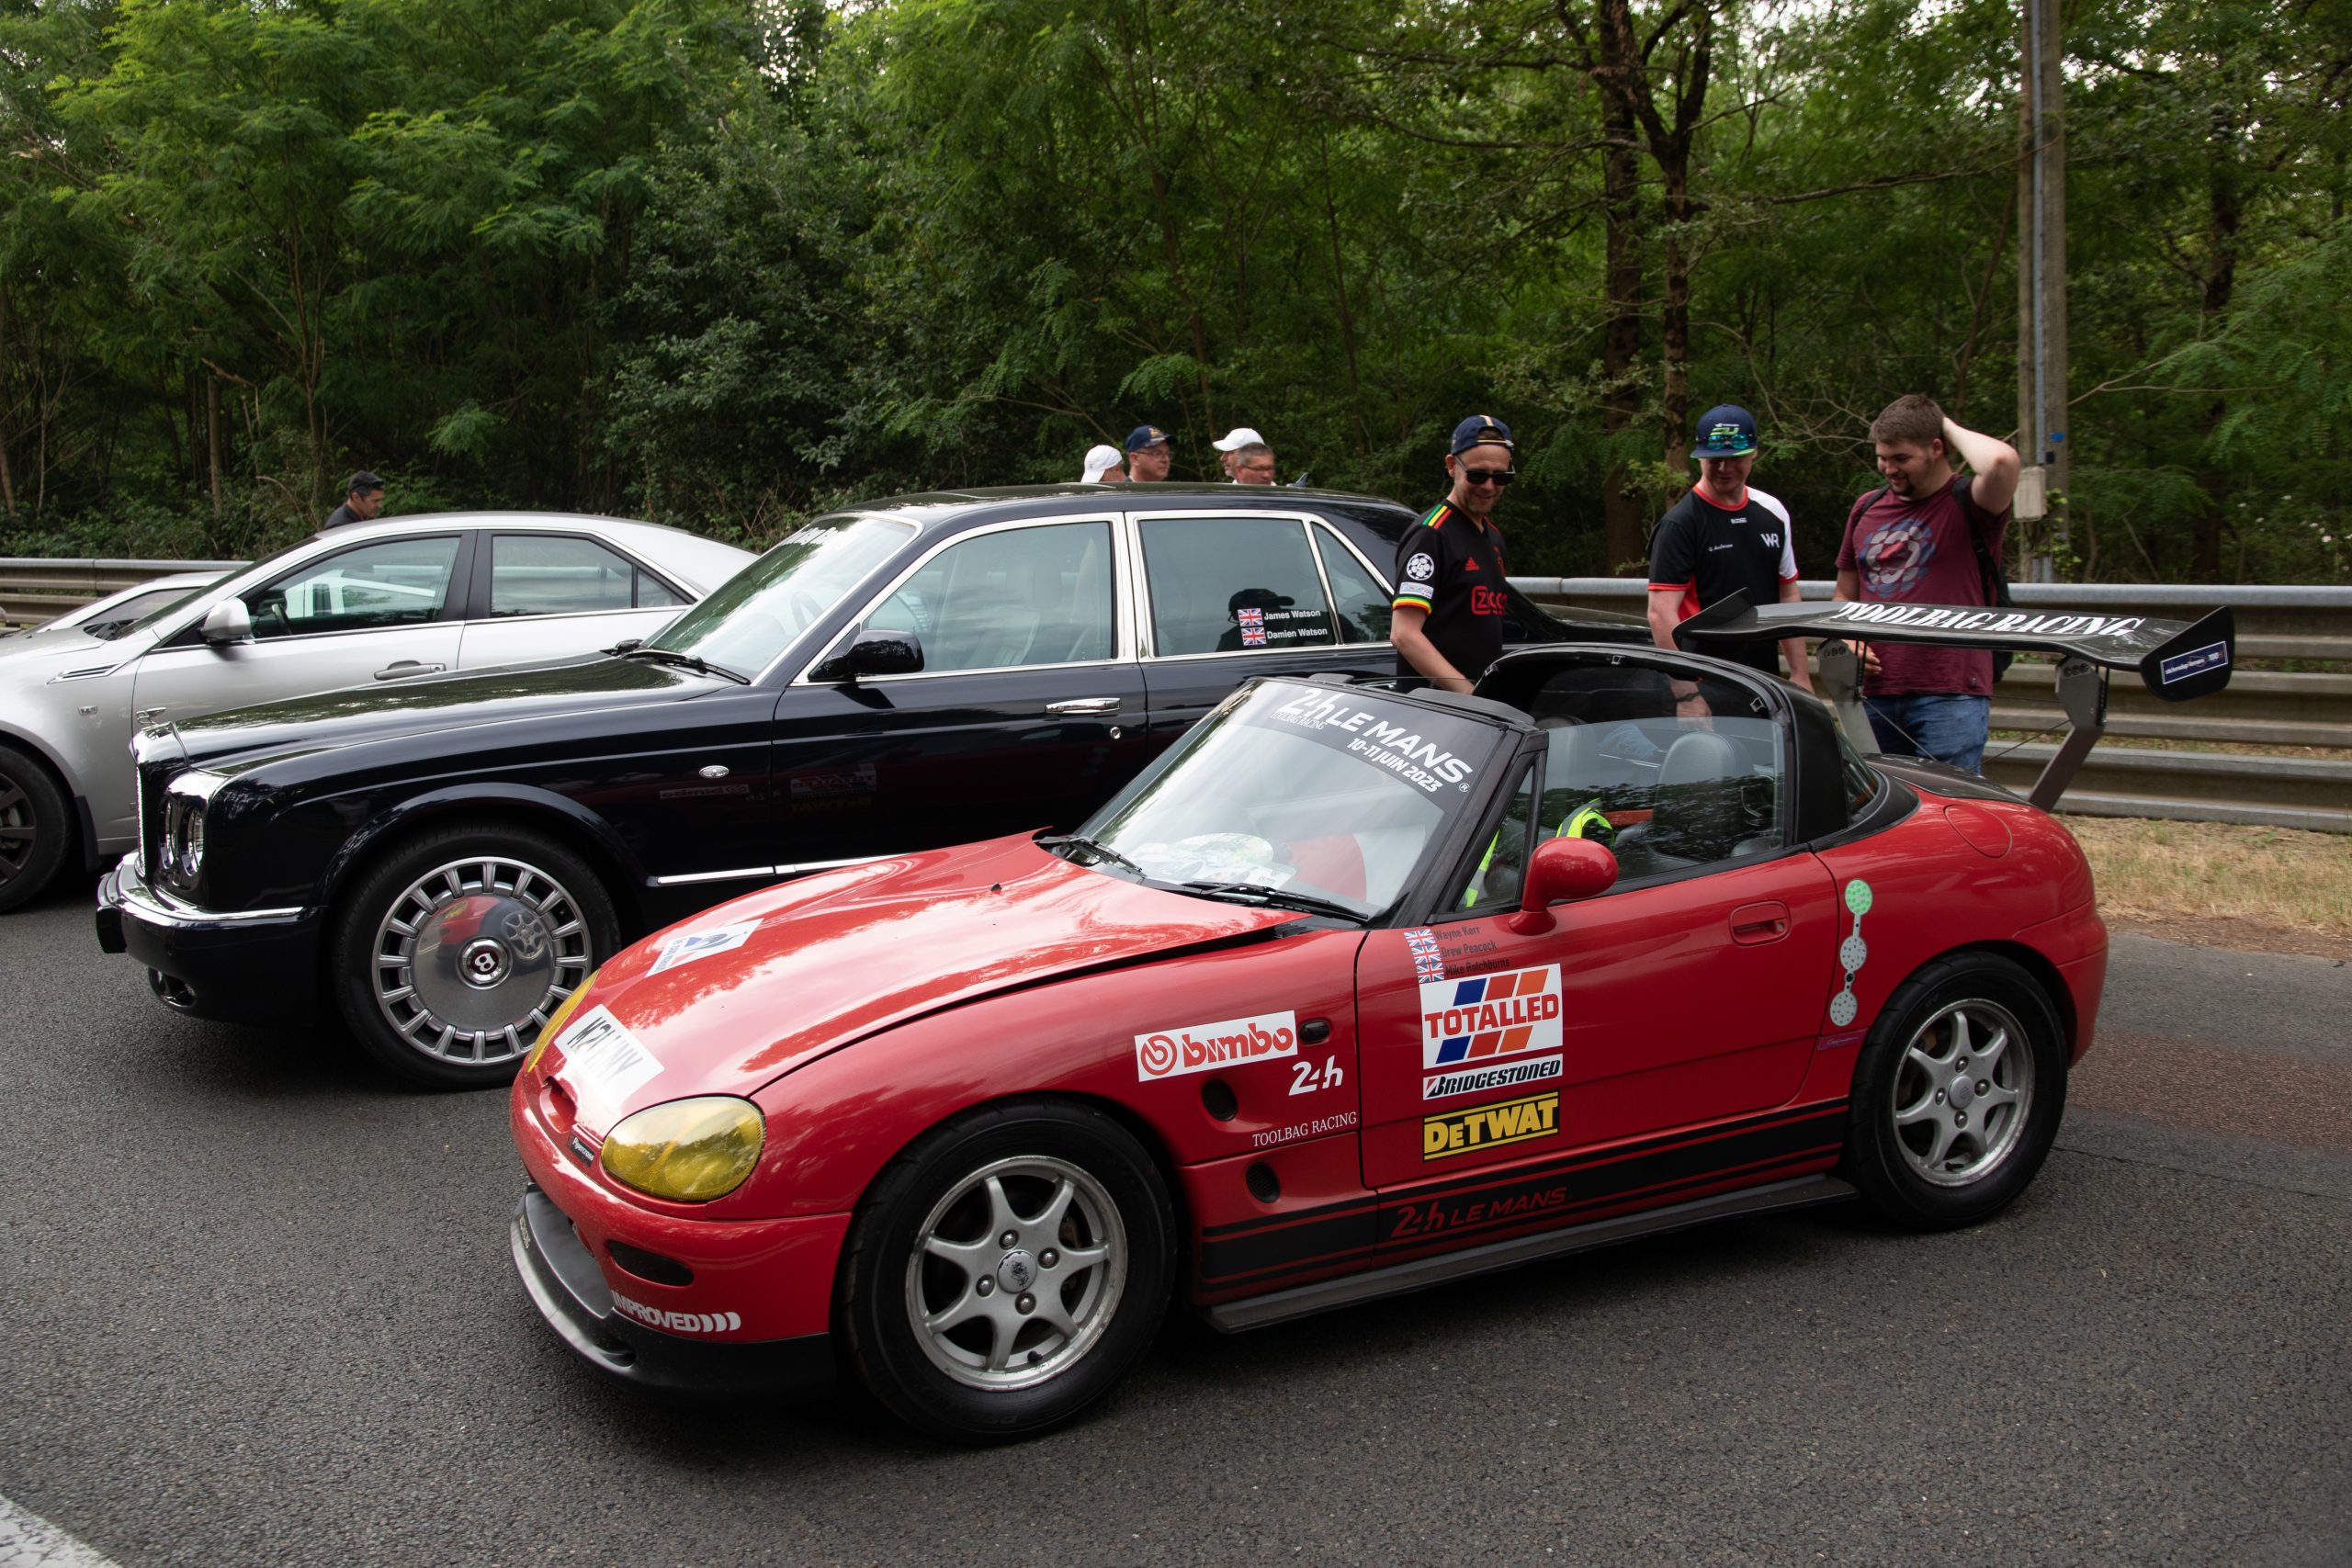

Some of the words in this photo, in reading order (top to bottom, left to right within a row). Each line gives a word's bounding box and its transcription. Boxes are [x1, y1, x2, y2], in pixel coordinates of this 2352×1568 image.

[1263, 612, 1291, 621] James
[1291, 609, 1321, 619] Watson
[1266, 629, 1297, 639] Damien
[1297, 627, 1328, 637] Watson
[1830, 602, 1998, 629] TOOLBAG
[1981, 614, 2146, 637] RACING
[1326, 707, 1375, 732] LE
[1363, 720, 1473, 784] MANS
[1347, 738, 1382, 758] 10-11
[1372, 750, 1410, 772] JUIN
[1402, 765, 1444, 793] 2023
[1433, 930, 1463, 942] Wayne
[1462, 926, 1481, 936] Kerr
[1441, 945, 1463, 957] Drew
[1463, 940, 1498, 955] Peacock
[1444, 963, 1464, 976] Mike
[1424, 993, 1560, 1039] TOTALLED
[1181, 1022, 1295, 1068] bimbo
[1426, 1059, 1561, 1099] BRIDGESTONED
[1252, 1122, 1308, 1147] TOOLBAG
[1311, 1111, 1357, 1134] RACING
[1449, 1203, 1486, 1226] LE
[1487, 1186, 1567, 1219] MANS
[610, 1289, 702, 1332] IMPROVED
